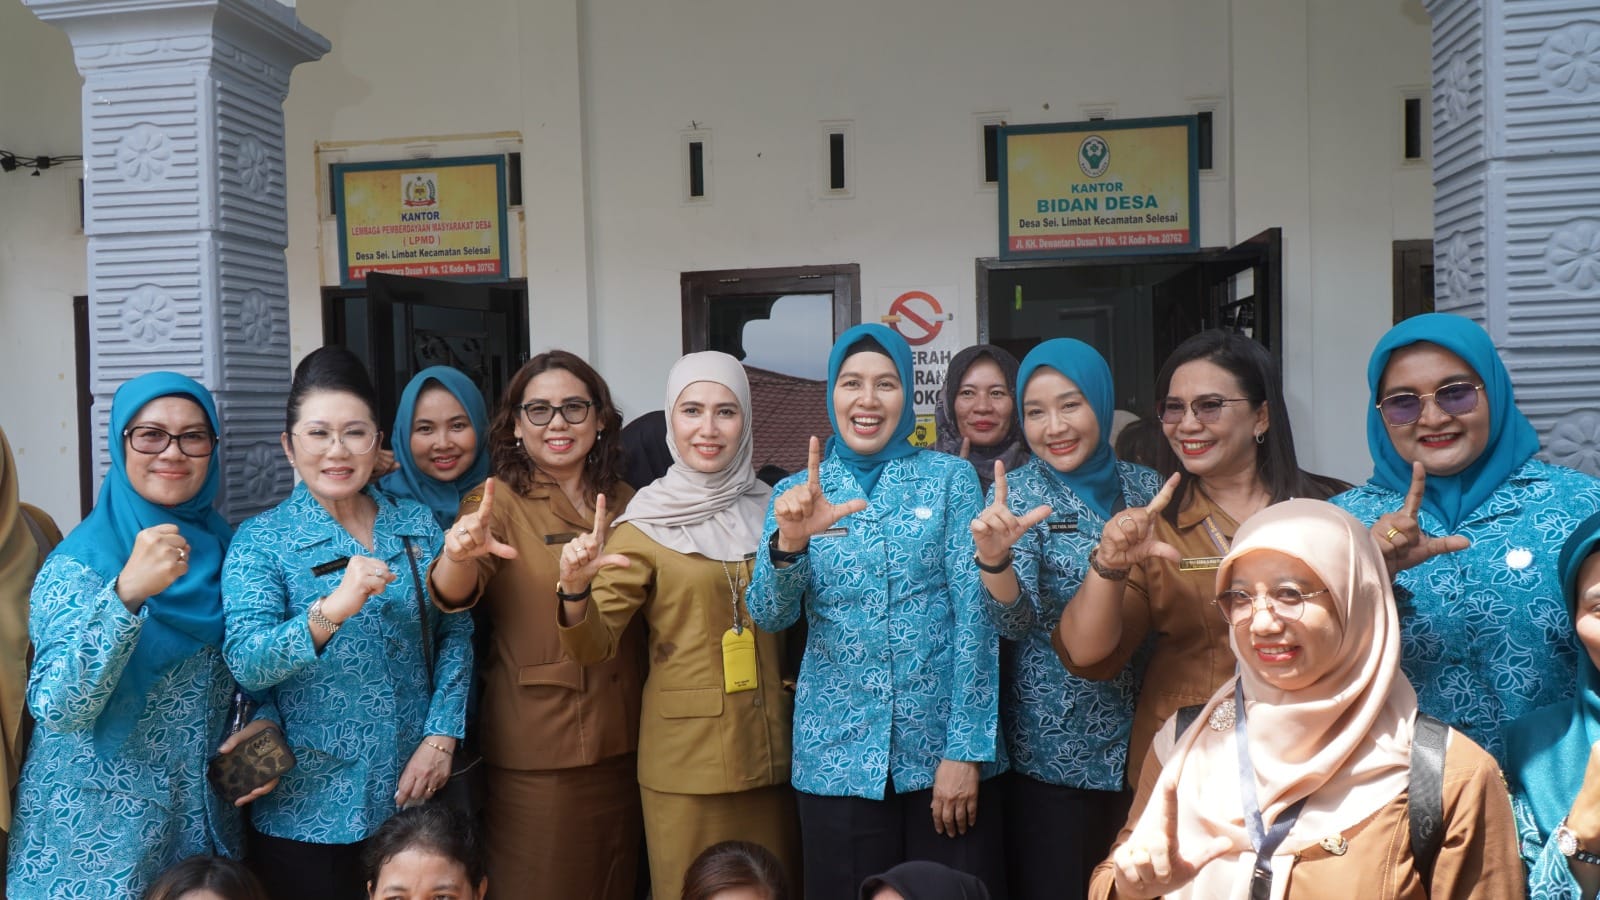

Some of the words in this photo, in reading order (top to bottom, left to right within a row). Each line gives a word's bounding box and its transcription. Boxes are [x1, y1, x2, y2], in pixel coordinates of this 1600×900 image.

[1071, 182, 1123, 193] KANTOR
[1036, 198, 1098, 213] BIDAN
[1105, 195, 1158, 211] DESA
[401, 211, 440, 222] KANTOR
[1019, 219, 1040, 229] Desa
[1042, 217, 1059, 227] Sei.
[1062, 215, 1091, 227] Limbat
[1094, 214, 1143, 226] Kecamatan
[1146, 212, 1178, 223] Selesai
[352, 226, 380, 236] LEMBAGA
[382, 223, 431, 234] PEMBERDAYAAN
[432, 221, 473, 232] MASYARAKAT
[475, 220, 492, 230] DESA
[409, 235, 435, 245] LPMD
[1025, 239, 1038, 249] KH.
[1039, 238, 1076, 248] Dewantara
[1076, 237, 1097, 247] Dusun
[1098, 236, 1104, 246] V
[1105, 236, 1118, 246] No.
[1119, 235, 1127, 246] 12
[1128, 235, 1146, 245] Kode
[1147, 234, 1160, 244] Pos
[355, 251, 374, 261] Desa
[376, 250, 390, 260] Sei.
[392, 248, 417, 259] Limbat
[419, 247, 461, 258] Kecamatan
[463, 245, 491, 255] Selesai
[441, 264, 448, 274] 12
[912, 351, 951, 365] ERAH
